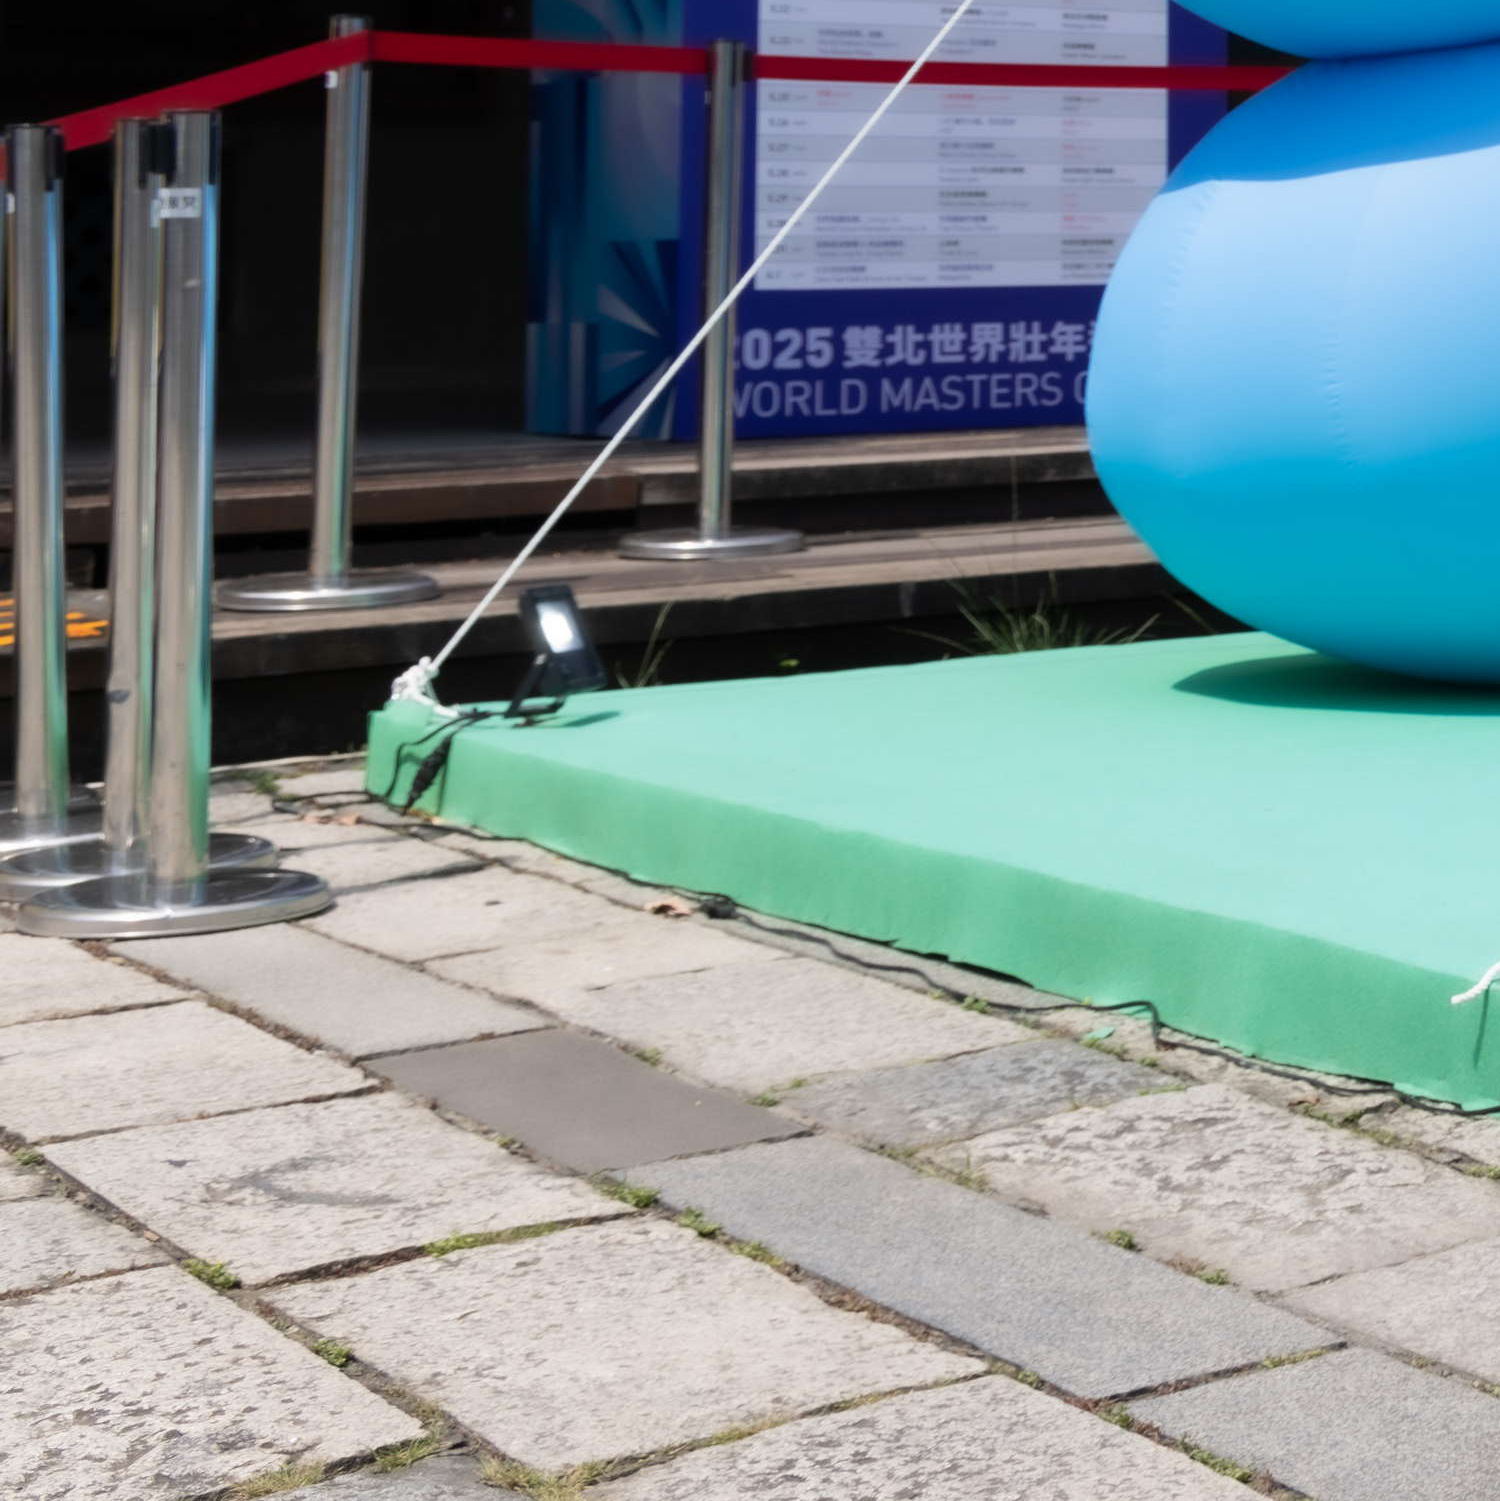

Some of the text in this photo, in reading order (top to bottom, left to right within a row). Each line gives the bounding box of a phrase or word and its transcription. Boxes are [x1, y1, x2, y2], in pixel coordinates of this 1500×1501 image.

[734, 319, 1095, 371] 025 雙北世界壯年
[880, 371, 1064, 414] MASTERS
